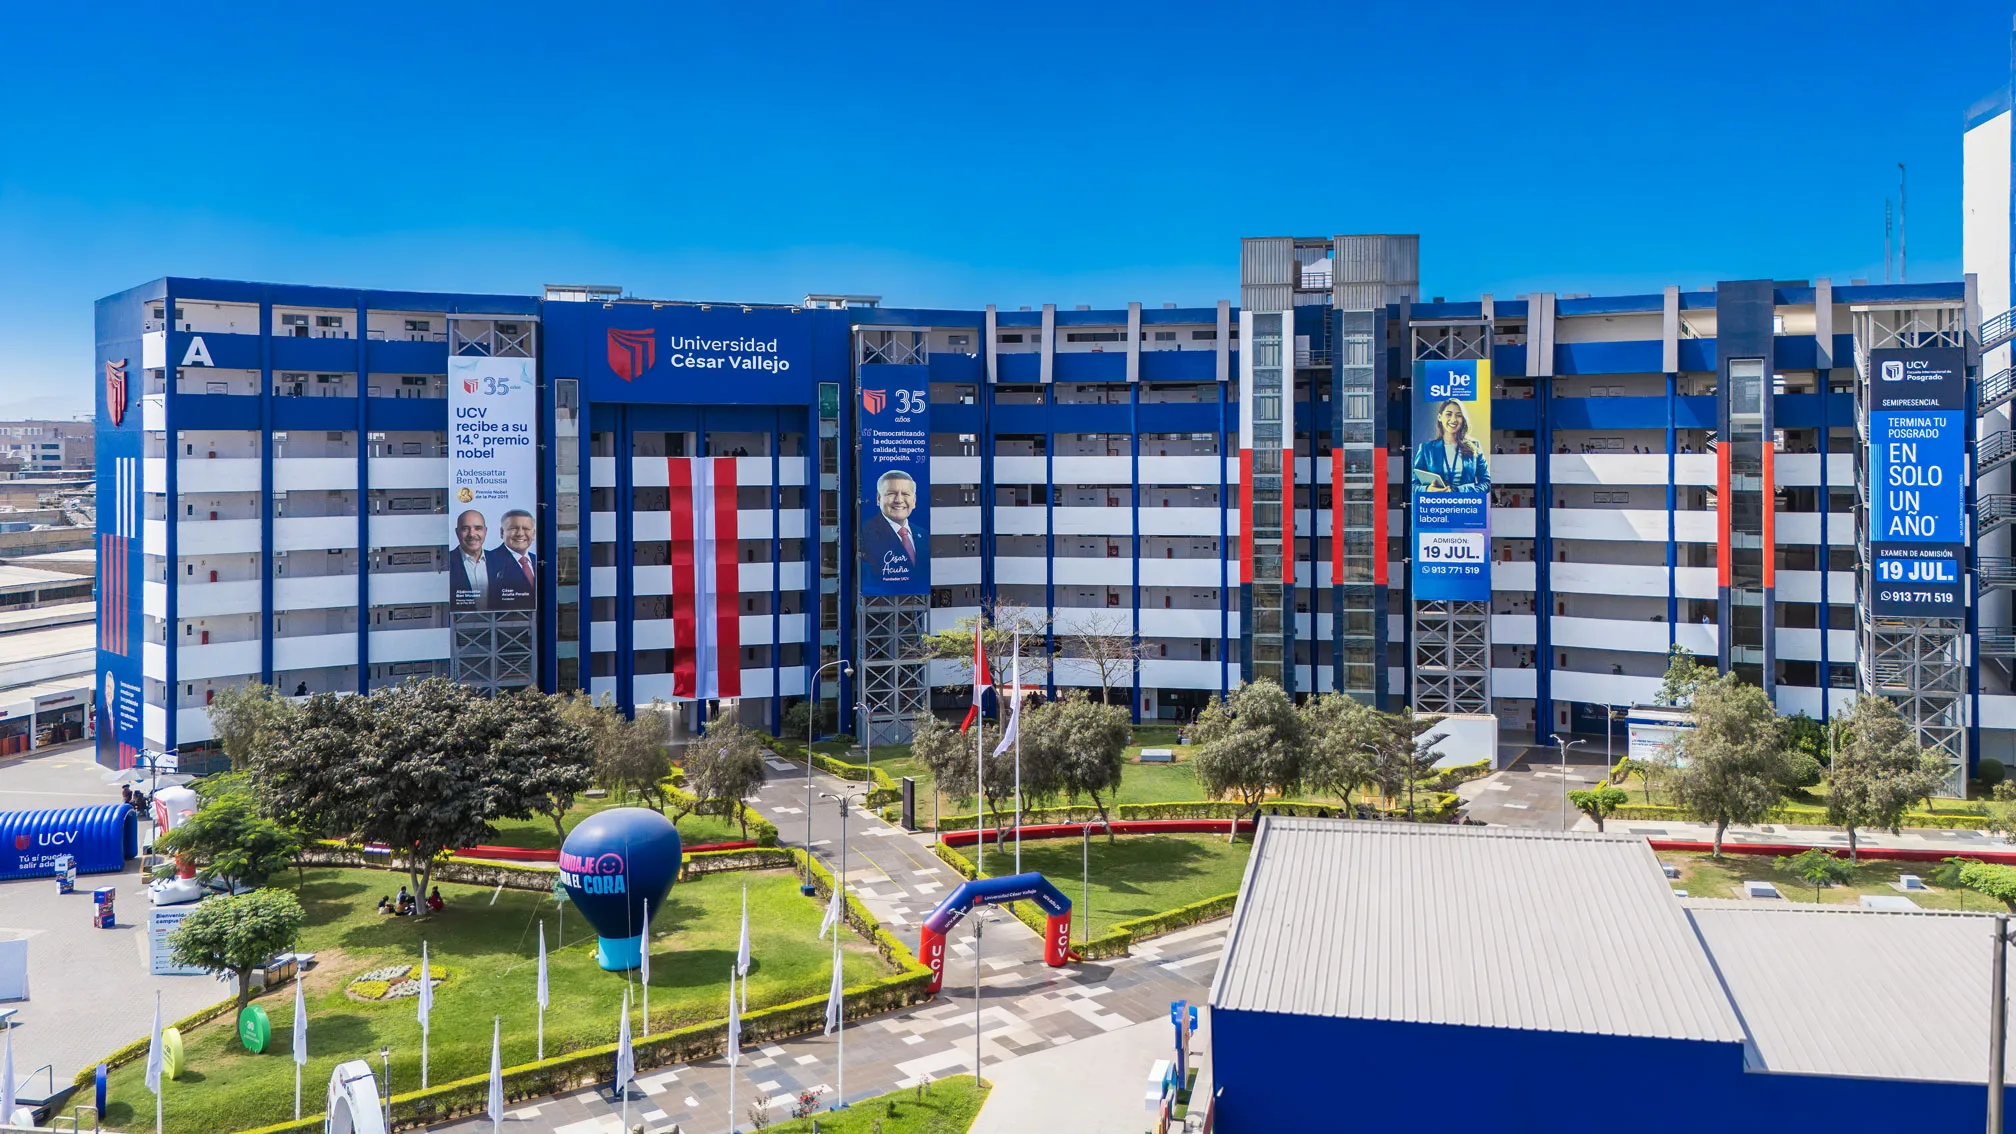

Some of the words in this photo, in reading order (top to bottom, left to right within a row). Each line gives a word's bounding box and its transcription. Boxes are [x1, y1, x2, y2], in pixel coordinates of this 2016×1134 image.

[181, 336, 214, 366] A
[671, 336, 777, 352] Universidad
[670, 352, 725, 368] César
[728, 356, 790, 374] Vallejo
[484, 376, 510, 395] 35
[895, 389, 926, 413] 35
[456, 407, 487, 418] UCV
[456, 421, 498, 432] recibe
[501, 423, 509, 432] a
[512, 423, 527, 432] su
[1888, 418, 1932, 427] TERMINA
[1933, 418, 1946, 427] TU
[483, 434, 530, 447] premio
[1888, 428, 1939, 438] POSGRADO
[456, 448, 494, 459] nobel
[1889, 443, 1916, 463] EN
[1889, 465, 1942, 487] SOLO
[1420, 496, 1482, 504] Reconocemos
[1890, 490, 1920, 511] UN
[1430, 506, 1478, 514] experiencia
[1424, 546, 1440, 558] 19
[1444, 546, 1479, 559] JUL.
[1919, 549, 1953, 558] ADMISIÓN
[1880, 561, 1903, 580] 19
[1908, 562, 1954, 581] JUL.
[1892, 592, 1911, 601] 913
[1913, 592, 1931, 602] 771
[1934, 593, 1953, 603] 519
[39, 830, 78, 846] UCV
[584, 875, 625, 894] CORA
[1058, 924, 1068, 958] UCV
[930, 945, 942, 983] UCV
